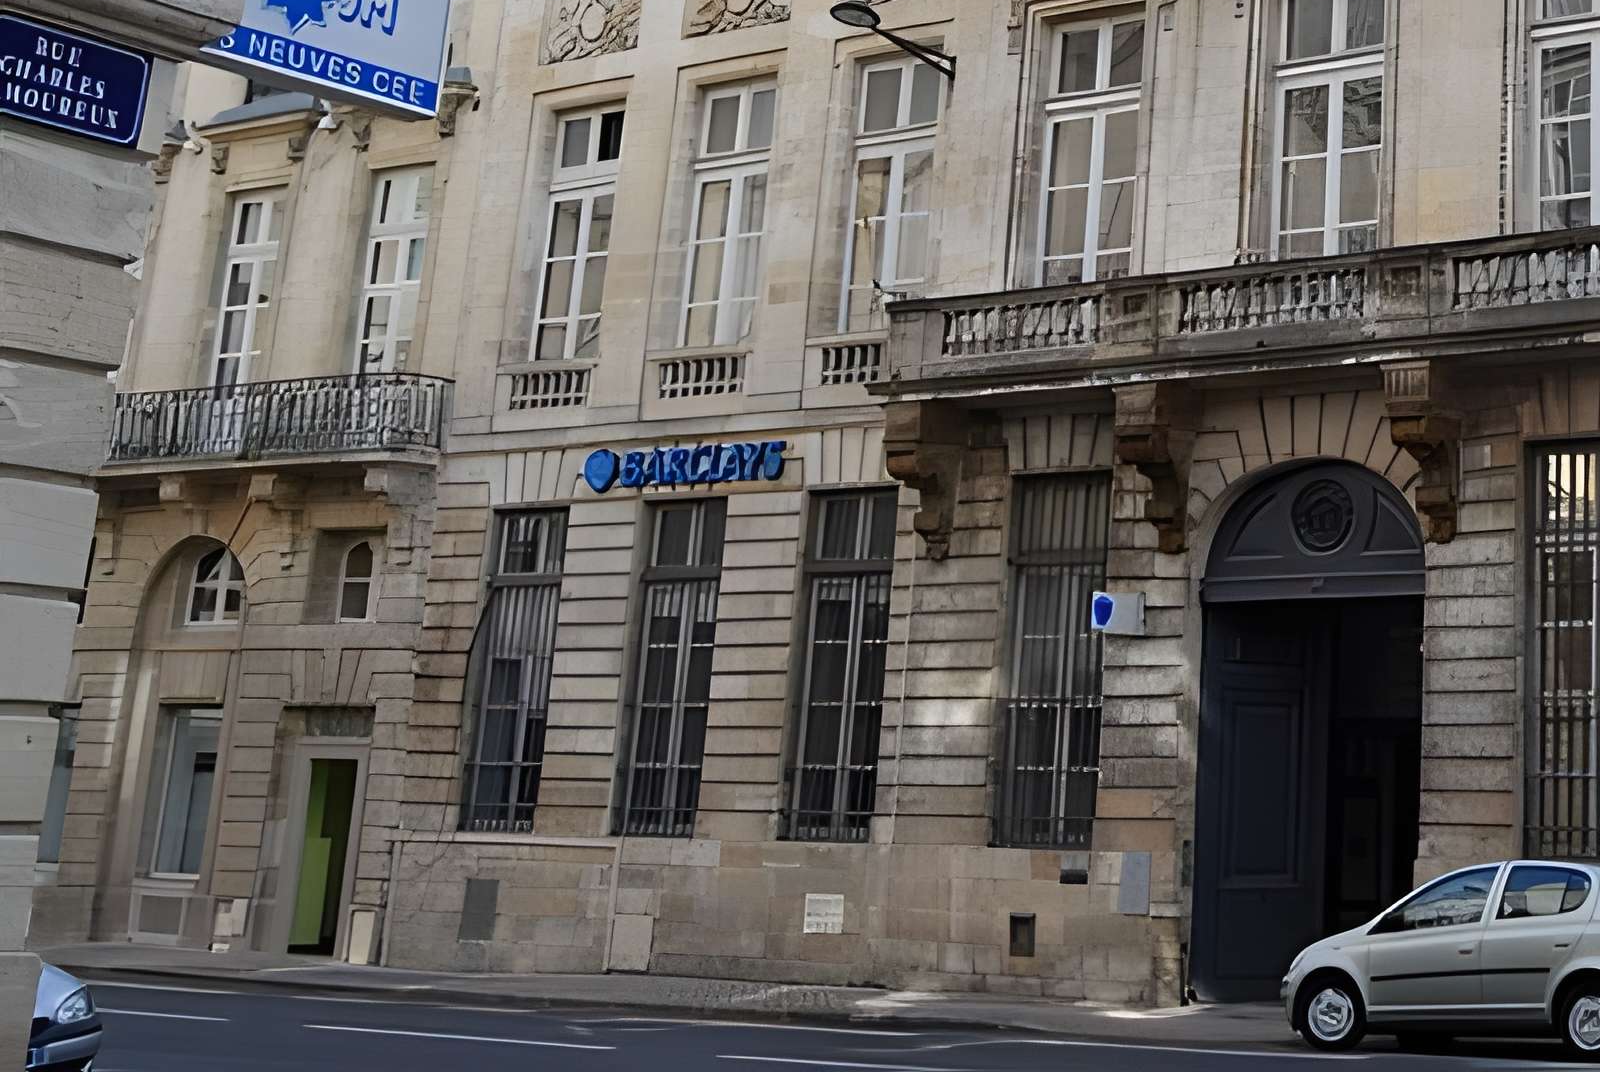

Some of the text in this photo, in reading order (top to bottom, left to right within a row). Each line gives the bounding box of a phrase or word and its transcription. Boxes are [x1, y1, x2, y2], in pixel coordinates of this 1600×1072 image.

[36, 36, 82, 67] RUE
[249, 32, 362, 85] NEUVES
[0, 55, 105, 99] CHARLES
[0, 82, 118, 129] MOUREUX
[619, 440, 788, 489] BARCLAYS
